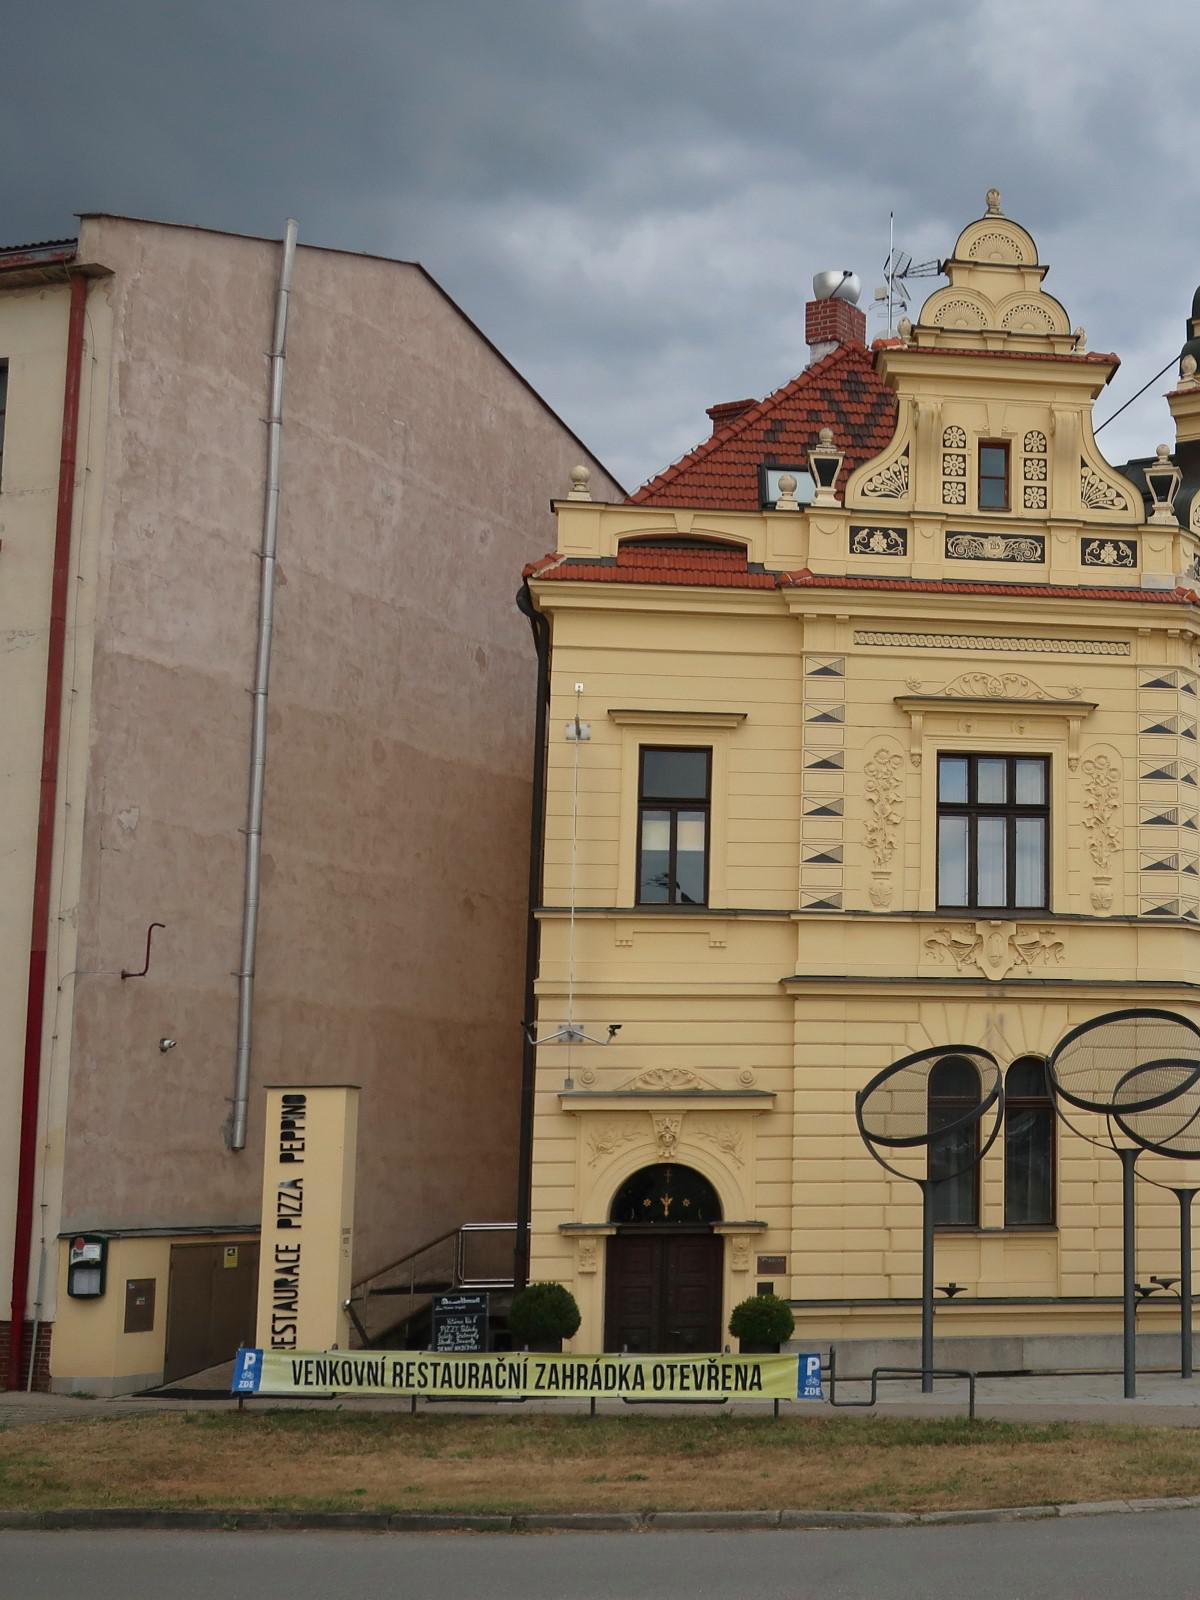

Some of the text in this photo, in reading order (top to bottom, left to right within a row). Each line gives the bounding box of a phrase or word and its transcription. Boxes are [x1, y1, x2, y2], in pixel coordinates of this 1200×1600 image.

[271, 1094, 307, 1349] ESTAURACE PIZZA PEPPINO
[243, 1352, 256, 1370] P
[806, 1357, 820, 1377] P
[292, 1356, 763, 1391] VENKOVNÍ RESTAURAČNÍ ZAHRÁDKA OTEVŘENA
[238, 1380, 254, 1389] ZDE
[804, 1386, 821, 1396] ZDE
